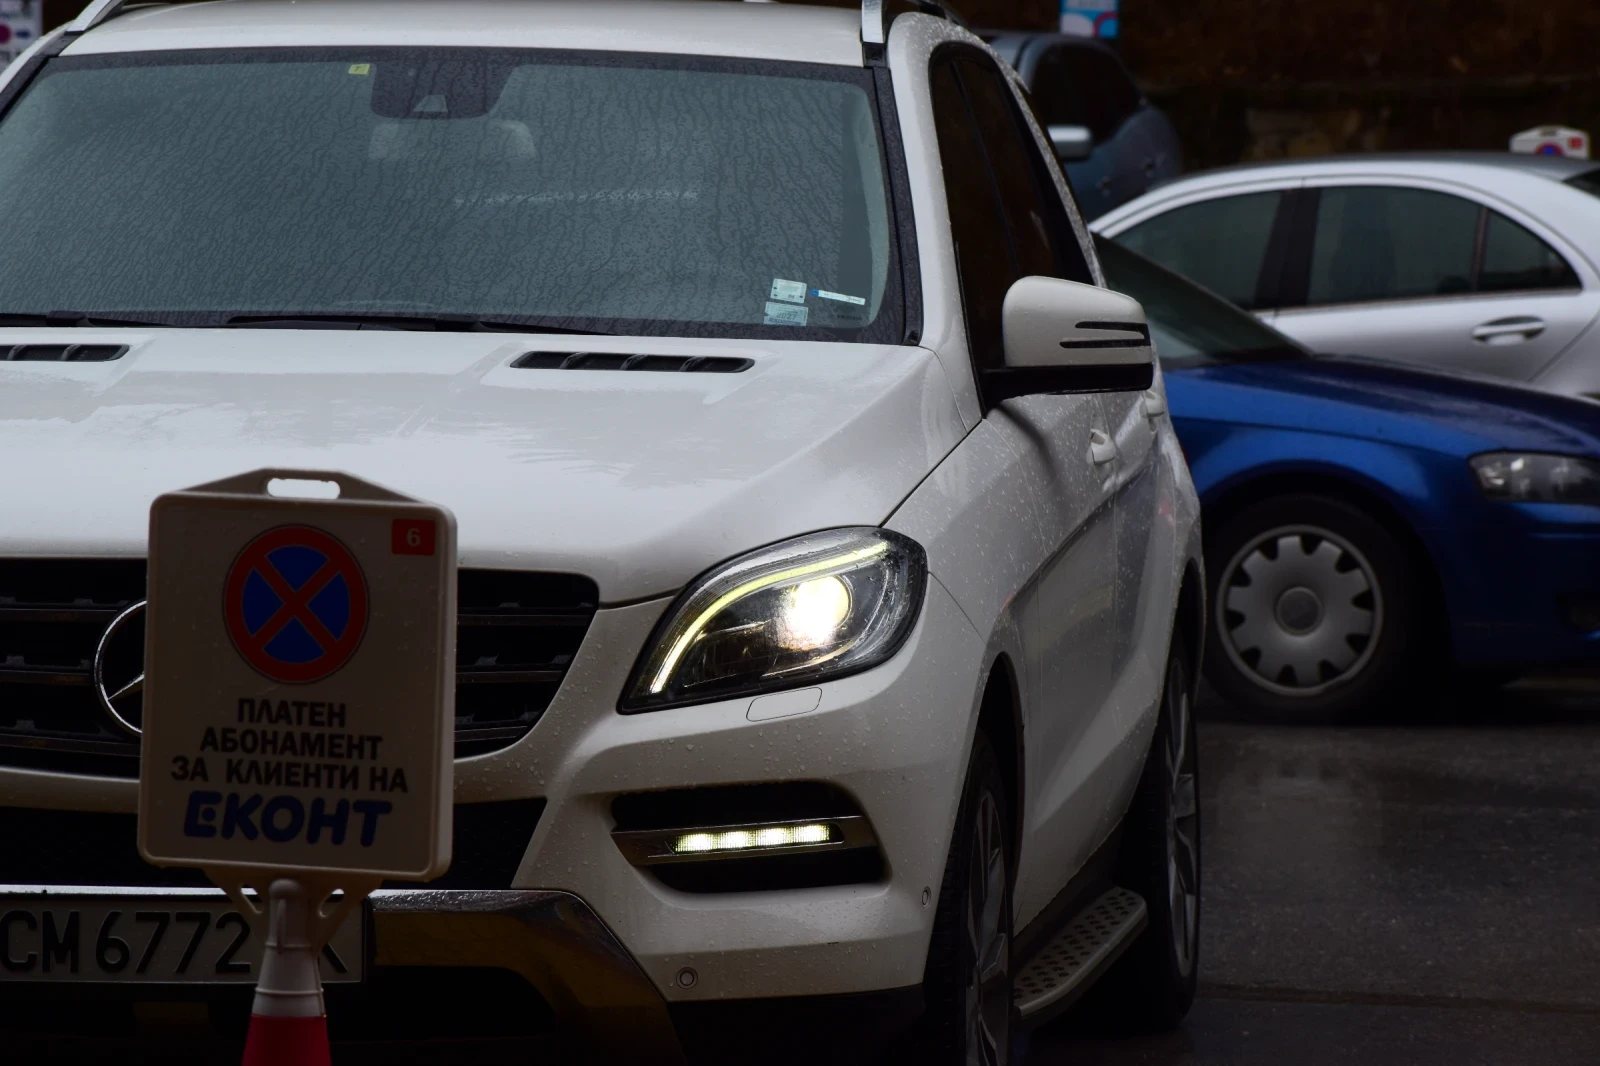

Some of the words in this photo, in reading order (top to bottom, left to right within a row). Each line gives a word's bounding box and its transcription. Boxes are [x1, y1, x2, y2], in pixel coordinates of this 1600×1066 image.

[406, 527, 421, 547] 6
[239, 699, 345, 726] ПЛАТЕН
[200, 729, 382, 759] АБОНАМЕНТ
[171, 757, 208, 781] ЗА
[226, 760, 358, 788] КЛИЕНТИ
[369, 768, 409, 792] НА
[184, 791, 391, 847] ЕКОНТ
[96, 911, 251, 973] 6772
